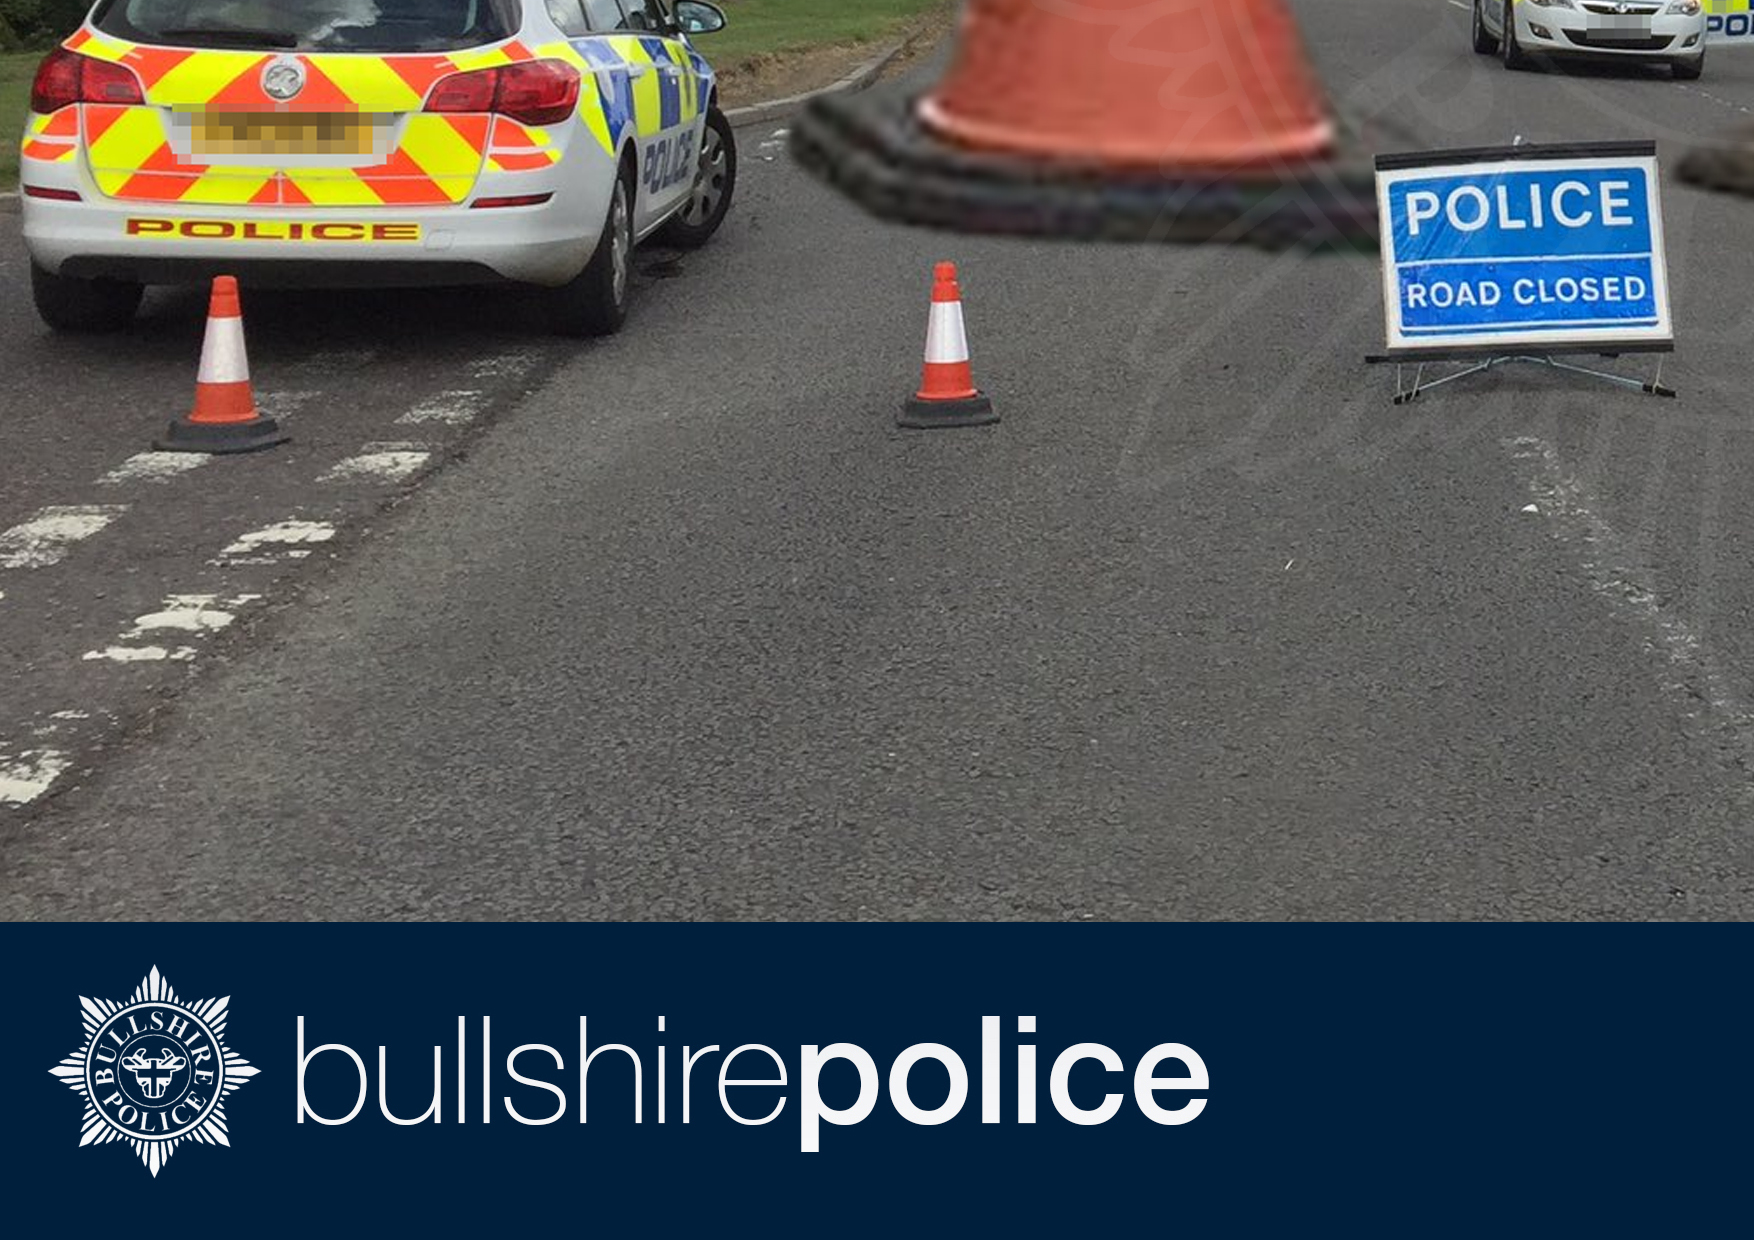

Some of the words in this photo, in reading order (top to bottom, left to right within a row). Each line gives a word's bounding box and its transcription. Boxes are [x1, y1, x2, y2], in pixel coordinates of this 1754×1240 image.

[1405, 180, 1634, 236] POLICE
[126, 218, 418, 241] POLICE
[1406, 280, 1502, 309] ROAD
[1512, 275, 1646, 305] CLOSED
